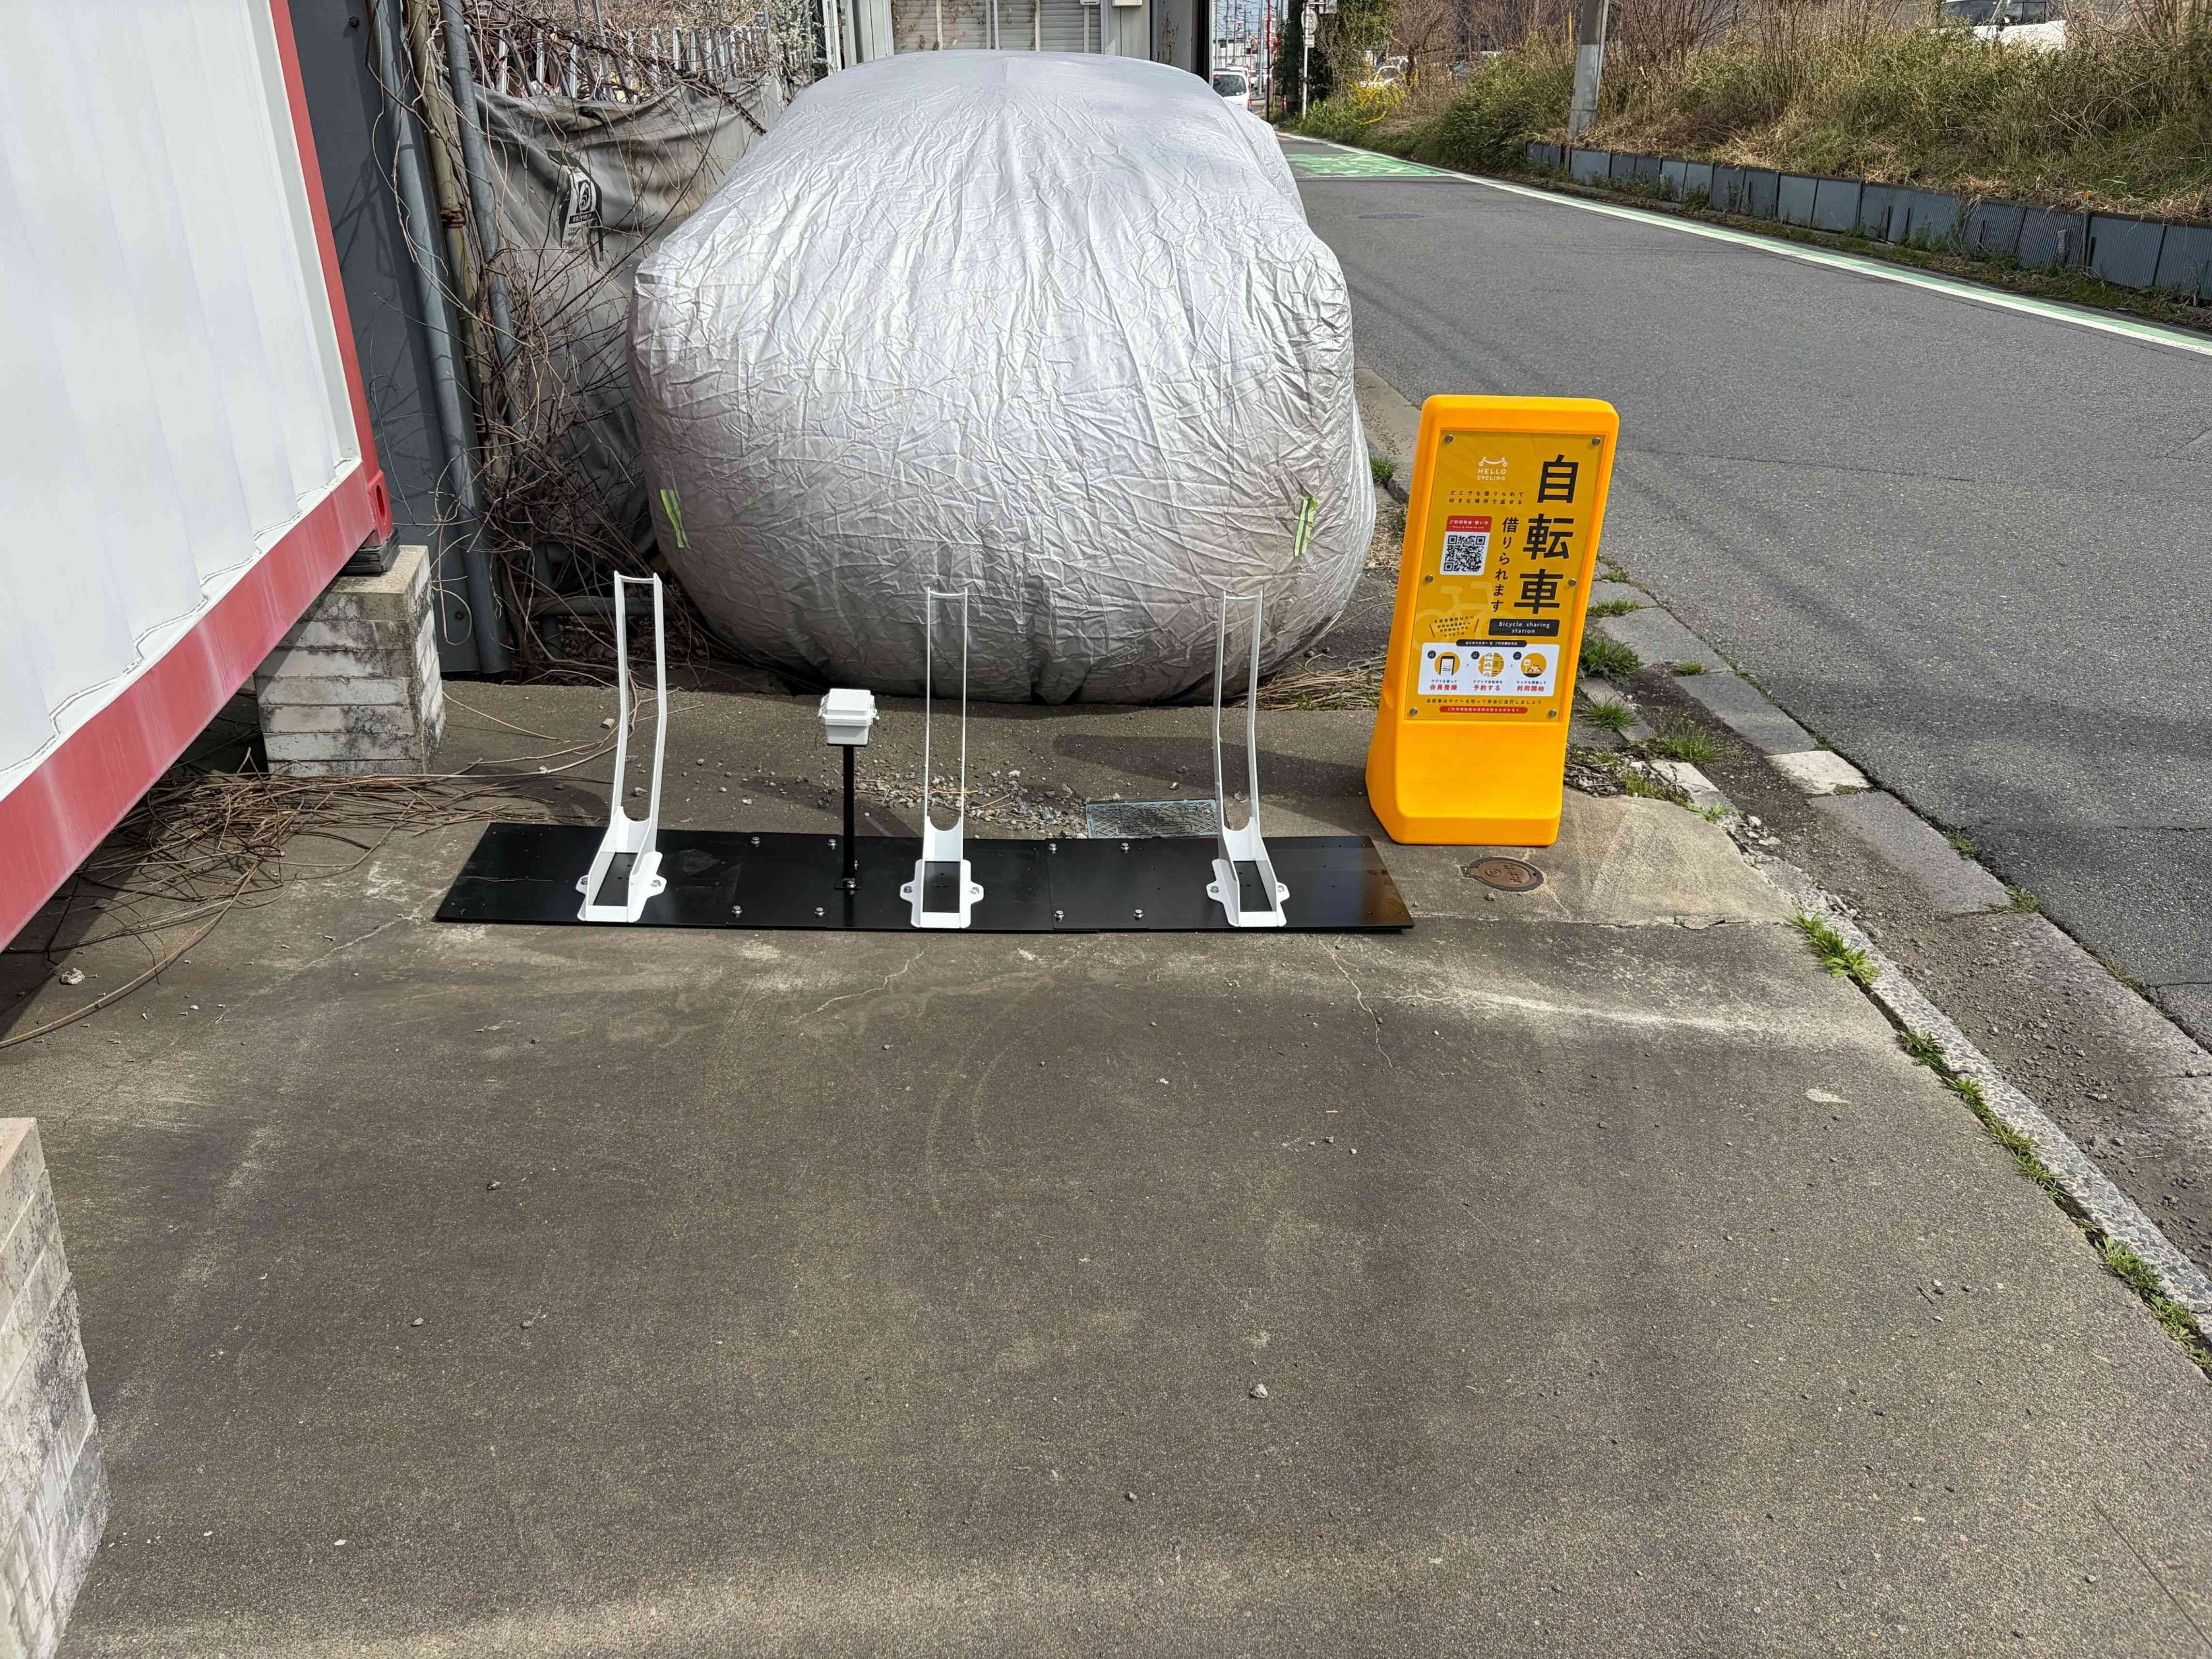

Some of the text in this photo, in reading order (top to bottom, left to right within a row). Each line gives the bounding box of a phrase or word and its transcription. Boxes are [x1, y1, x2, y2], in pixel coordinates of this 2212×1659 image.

[1491, 517, 1519, 612] 借りられます
[1514, 454, 1579, 614] 自転車
